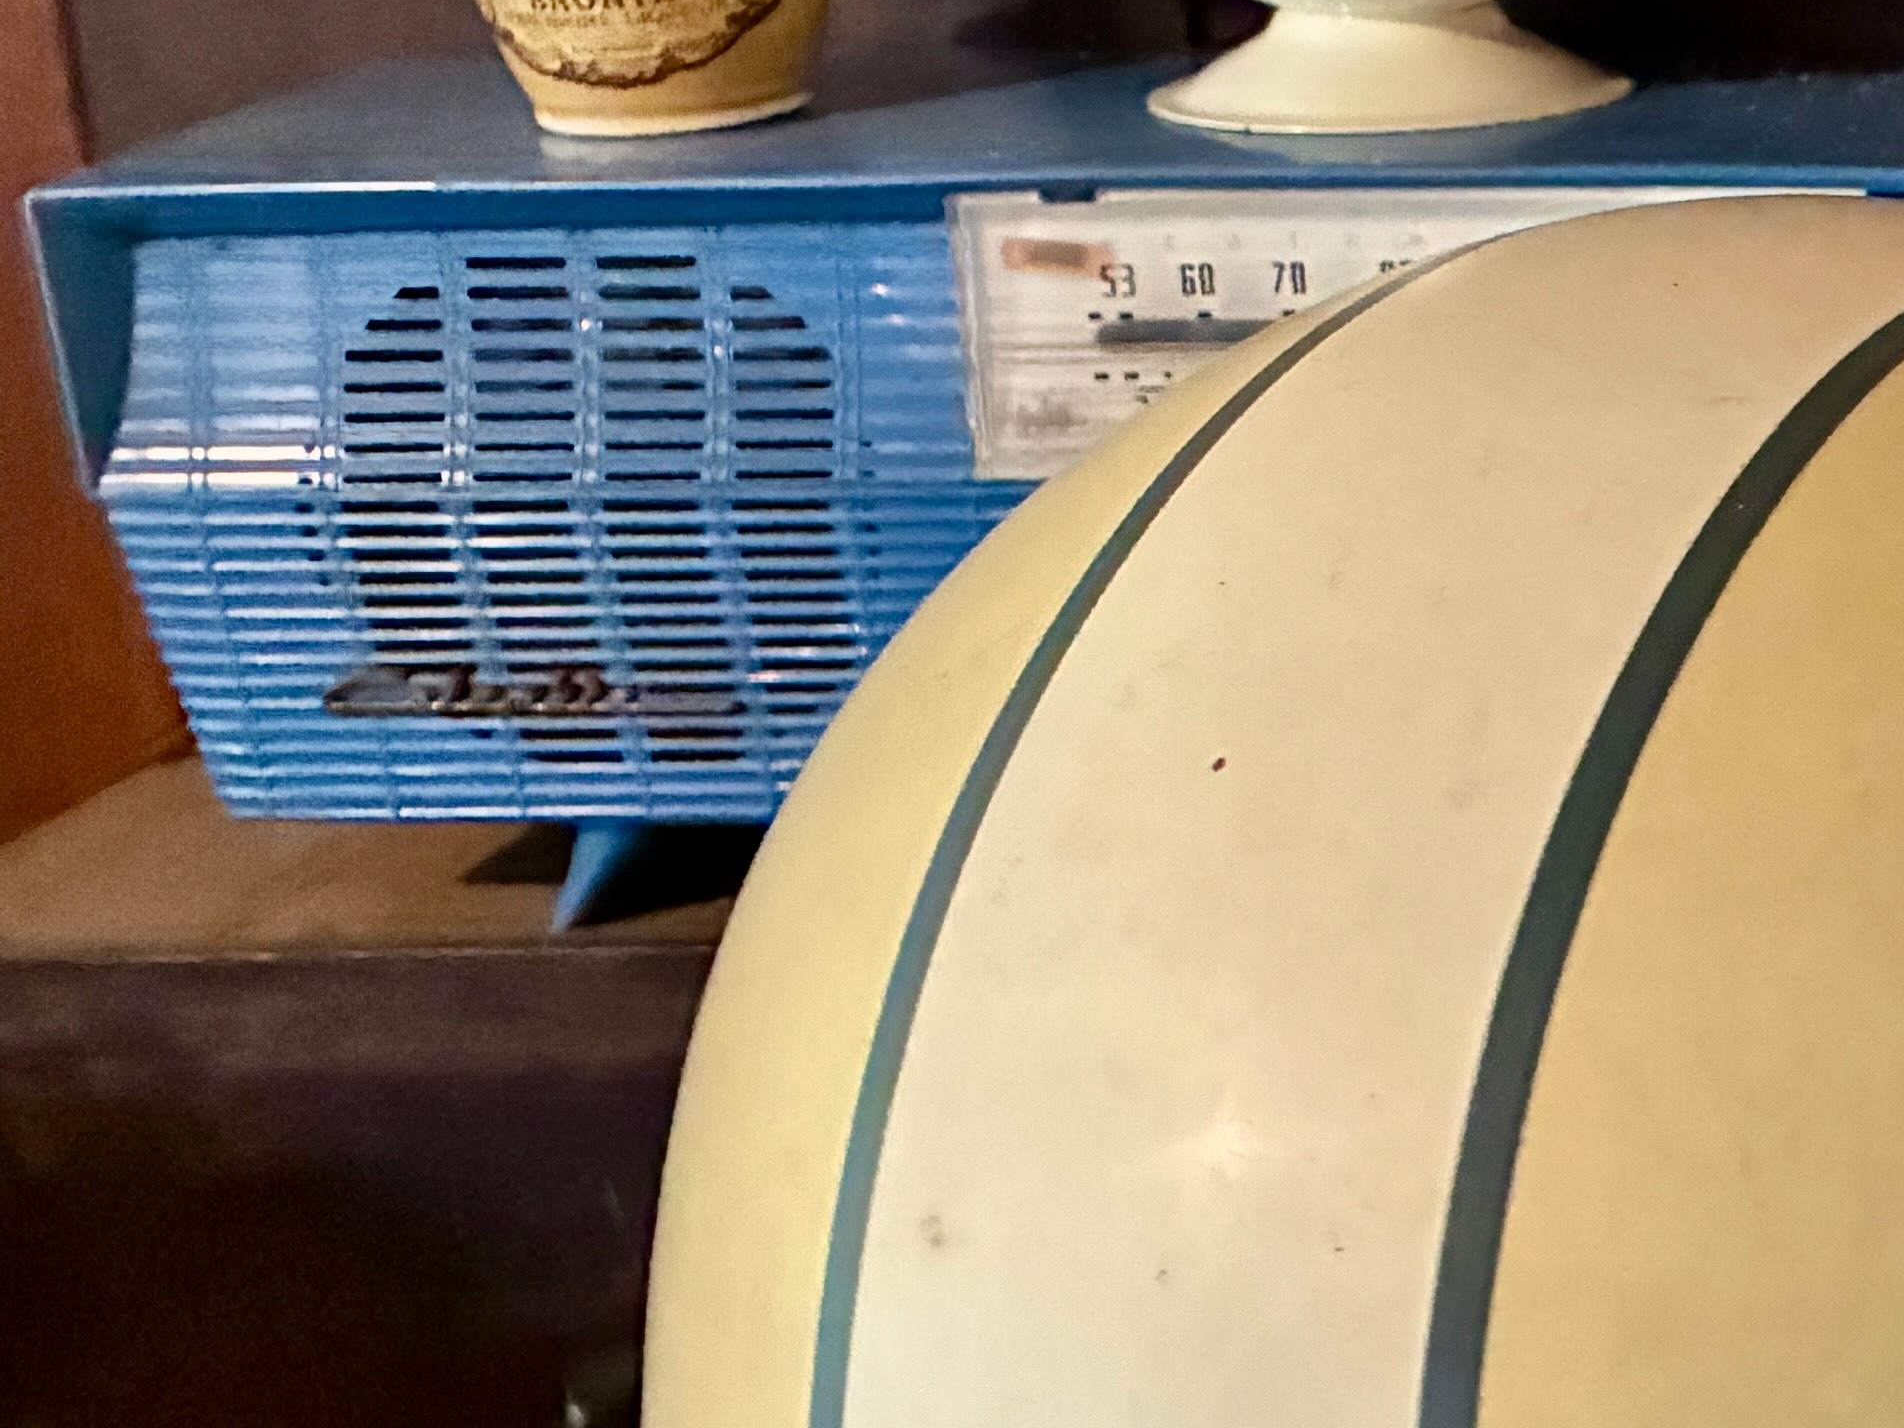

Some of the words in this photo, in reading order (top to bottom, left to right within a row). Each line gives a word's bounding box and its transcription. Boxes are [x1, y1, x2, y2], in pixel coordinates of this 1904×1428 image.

[1099, 261, 1137, 298] 53
[1178, 261, 1217, 297] 60
[1272, 260, 1308, 296] 70
